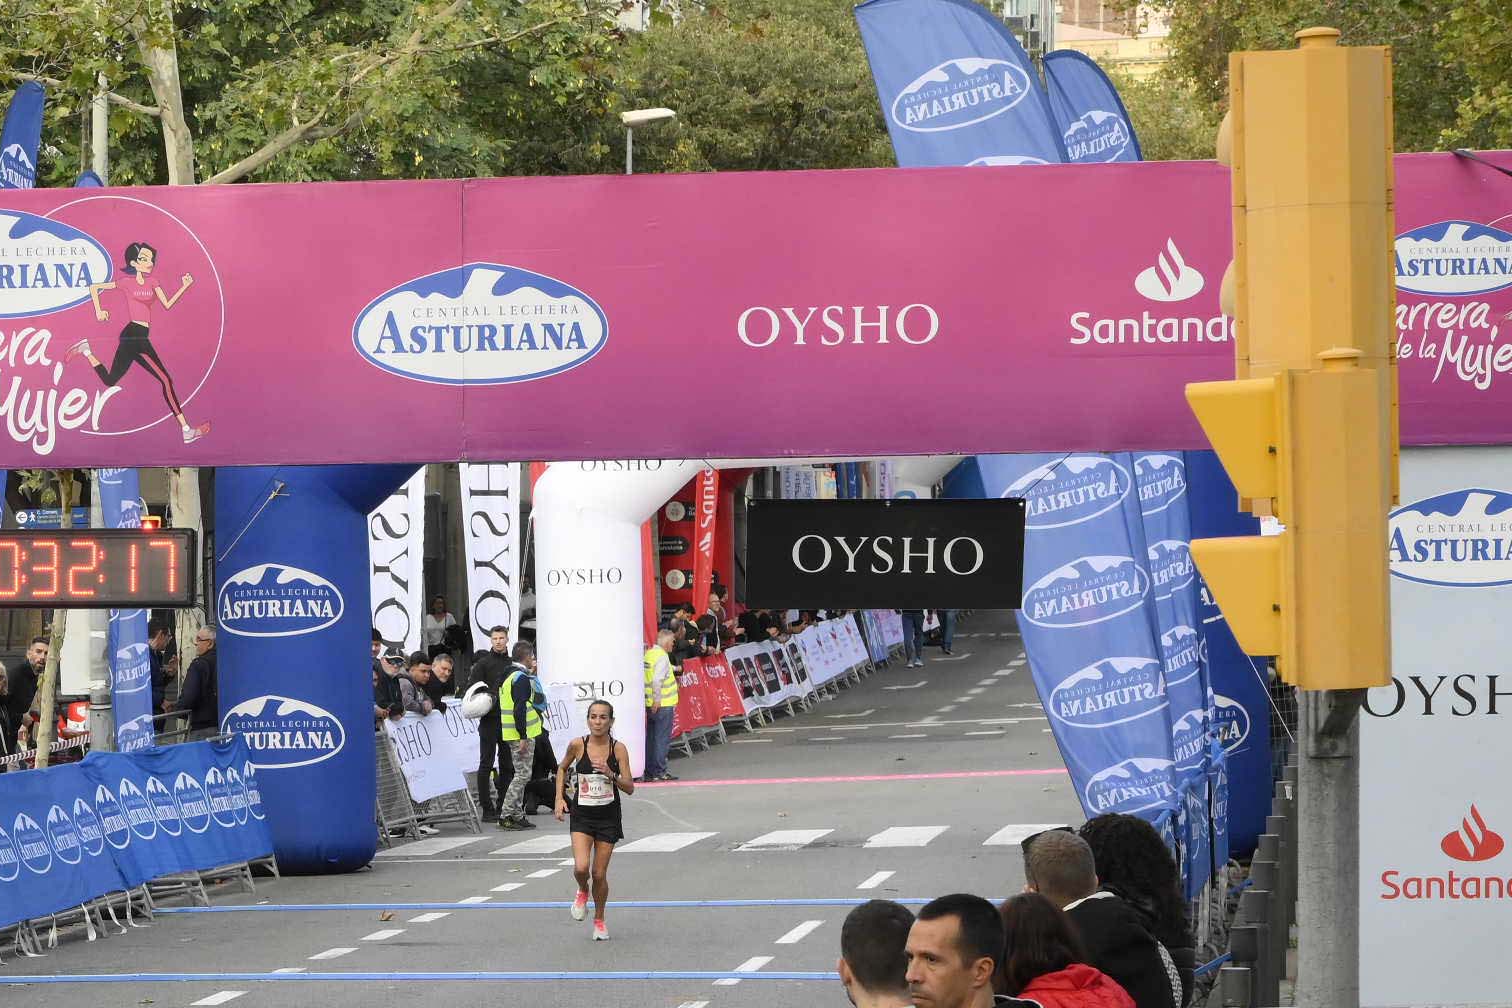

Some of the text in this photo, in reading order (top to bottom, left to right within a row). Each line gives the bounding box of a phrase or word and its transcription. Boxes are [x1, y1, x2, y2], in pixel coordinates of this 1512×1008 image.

[15, 245, 88, 257] LECHERA
[1466, 245, 1512, 254] LECHER
[411, 304, 580, 318] CENTRAL LECHERA
[1396, 302, 1491, 330] arrera
[372, 310, 588, 354] ASTURIANA
[737, 303, 939, 348] OYSHO
[1070, 310, 1237, 345] Santand
[1418, 330, 1437, 359] la
[1432, 325, 1512, 391] Muje
[1416, 522, 1484, 534] CENTRAL
[791, 534, 985, 576] OYSHO
[546, 567, 623, 586] OYSHO
[234, 588, 331, 597] CENTRAL LECHERA
[221, 593, 335, 621] ASTURIANA
[577, 679, 625, 697] SHO
[1362, 673, 1512, 719] OYSH
[226, 723, 336, 750] TURIANA
[1380, 869, 1512, 900] Santan
